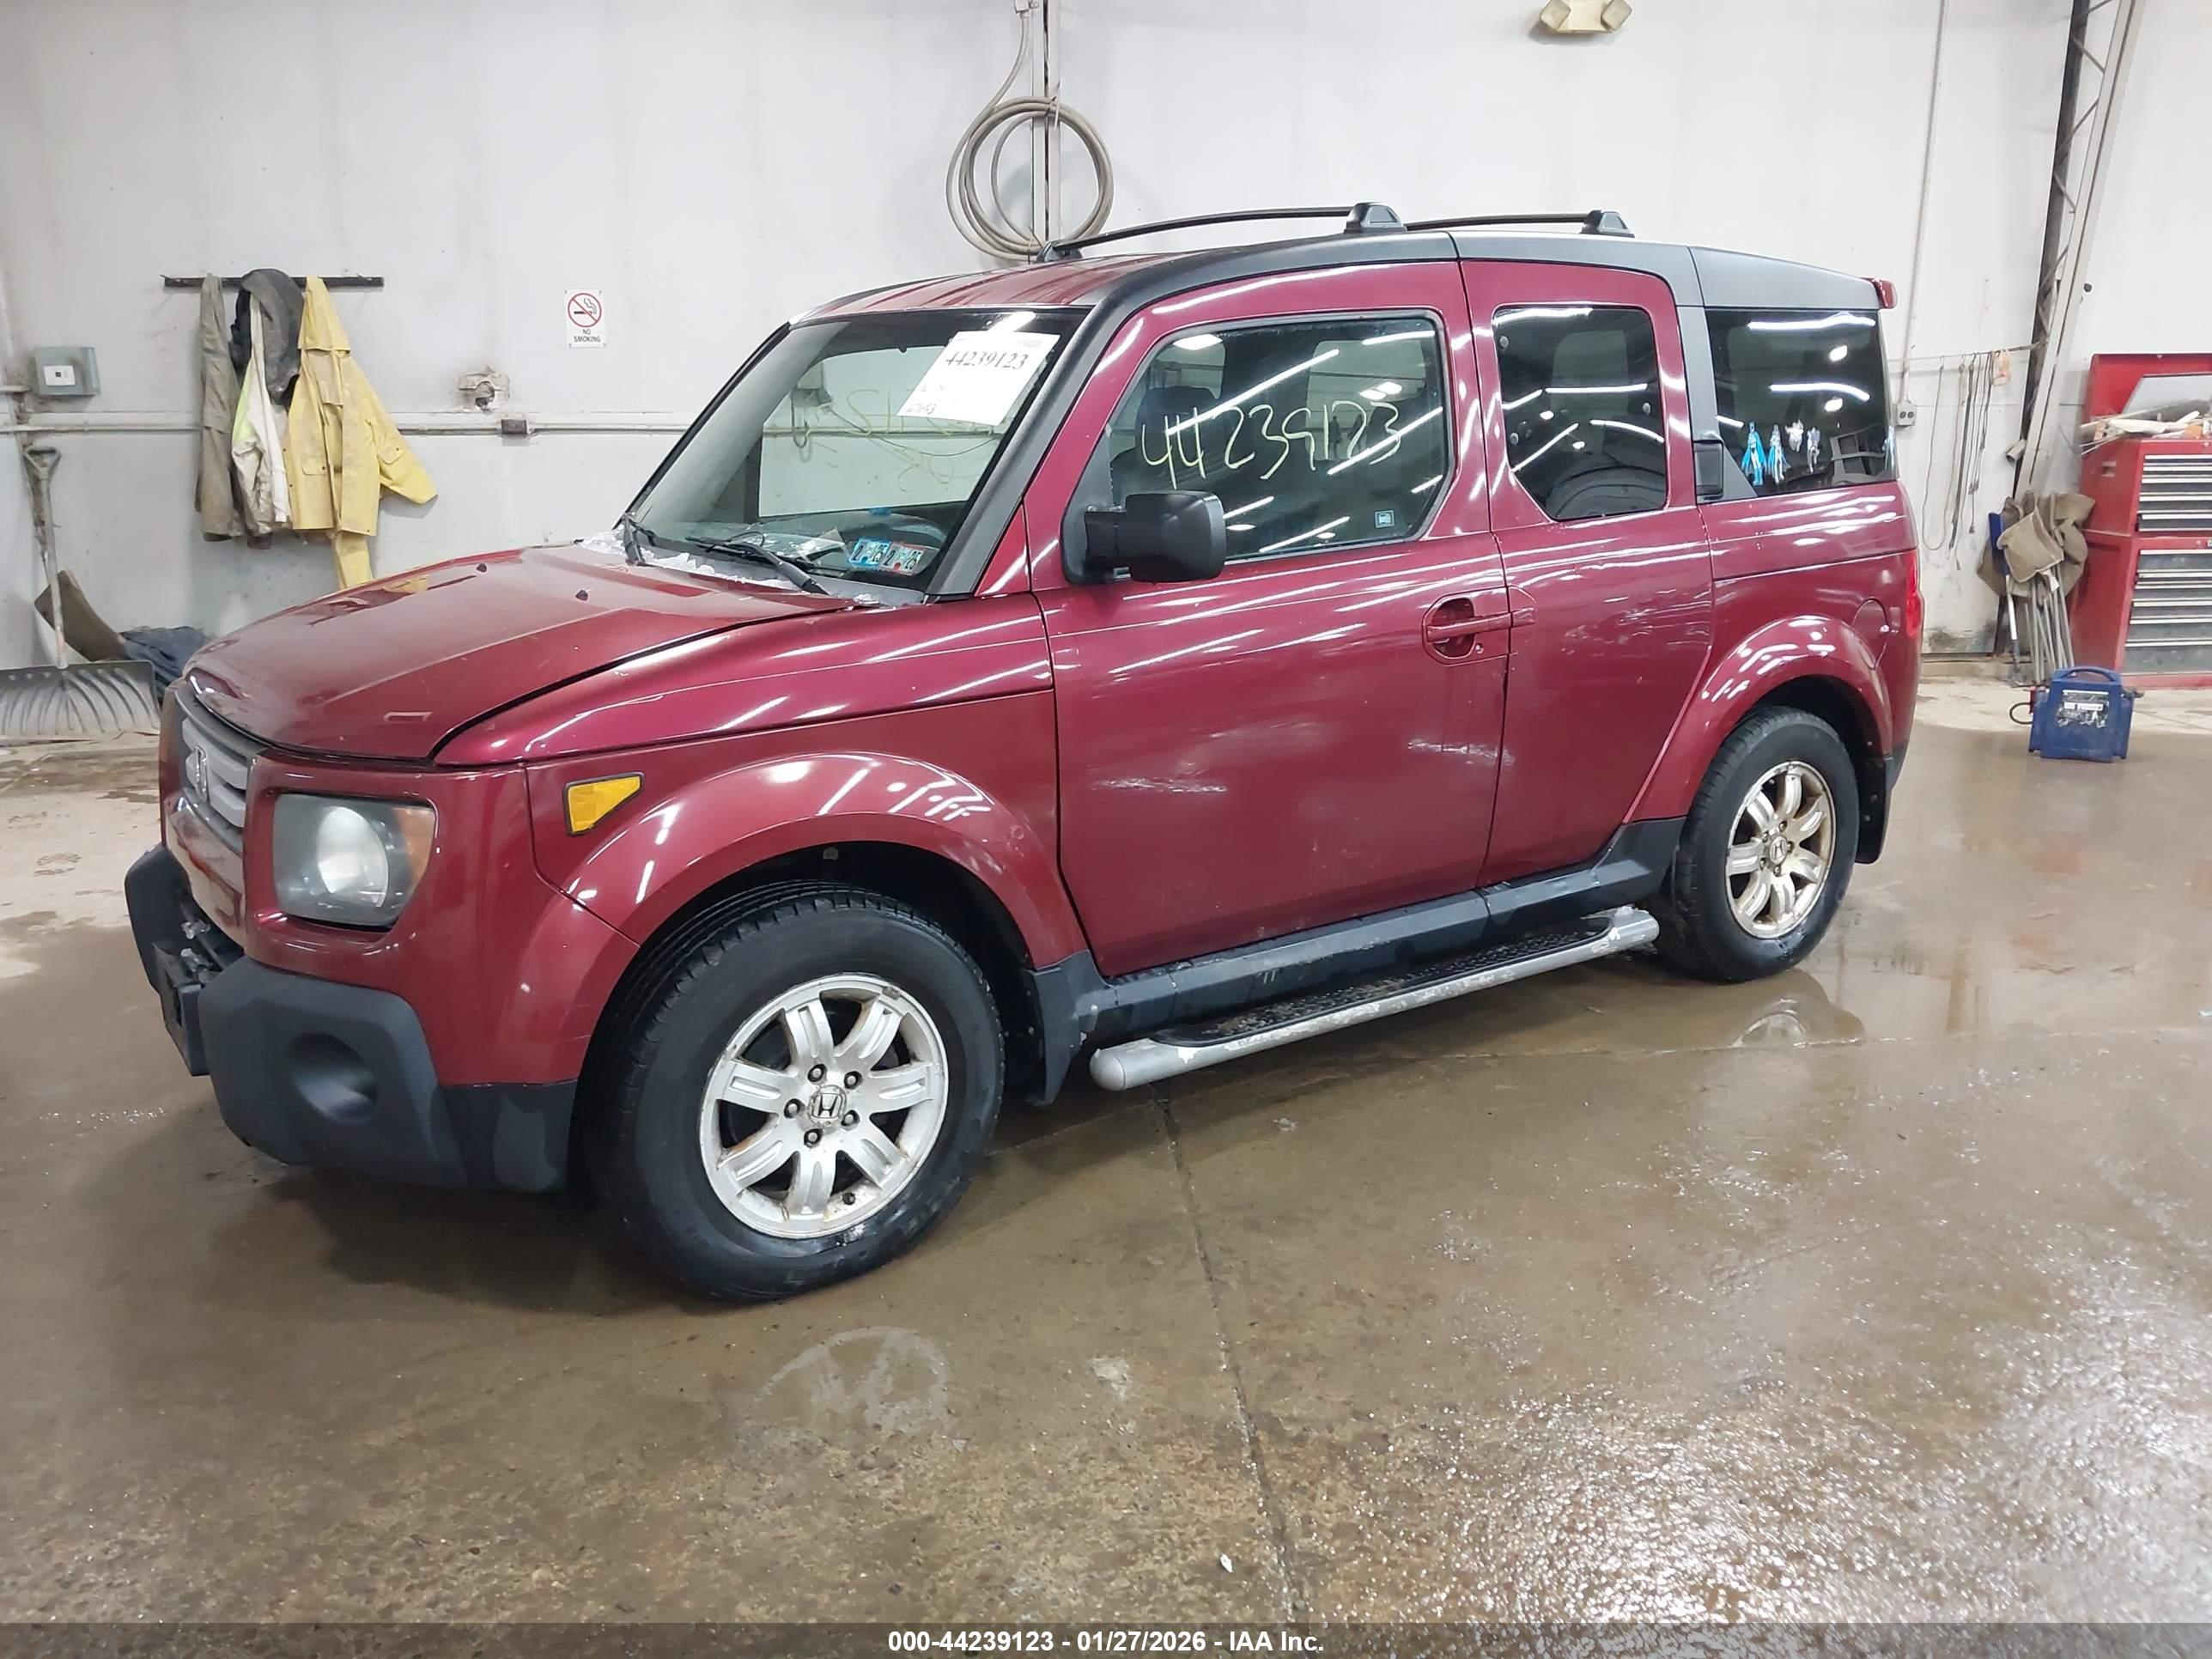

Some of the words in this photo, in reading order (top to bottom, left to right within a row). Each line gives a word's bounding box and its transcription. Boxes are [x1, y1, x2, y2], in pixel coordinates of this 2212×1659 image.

[945, 350, 1029, 370] 44239123
[1142, 401, 1401, 489] 44239123
[852, 545, 864, 561] 2
[884, 550, 896, 566] 2
